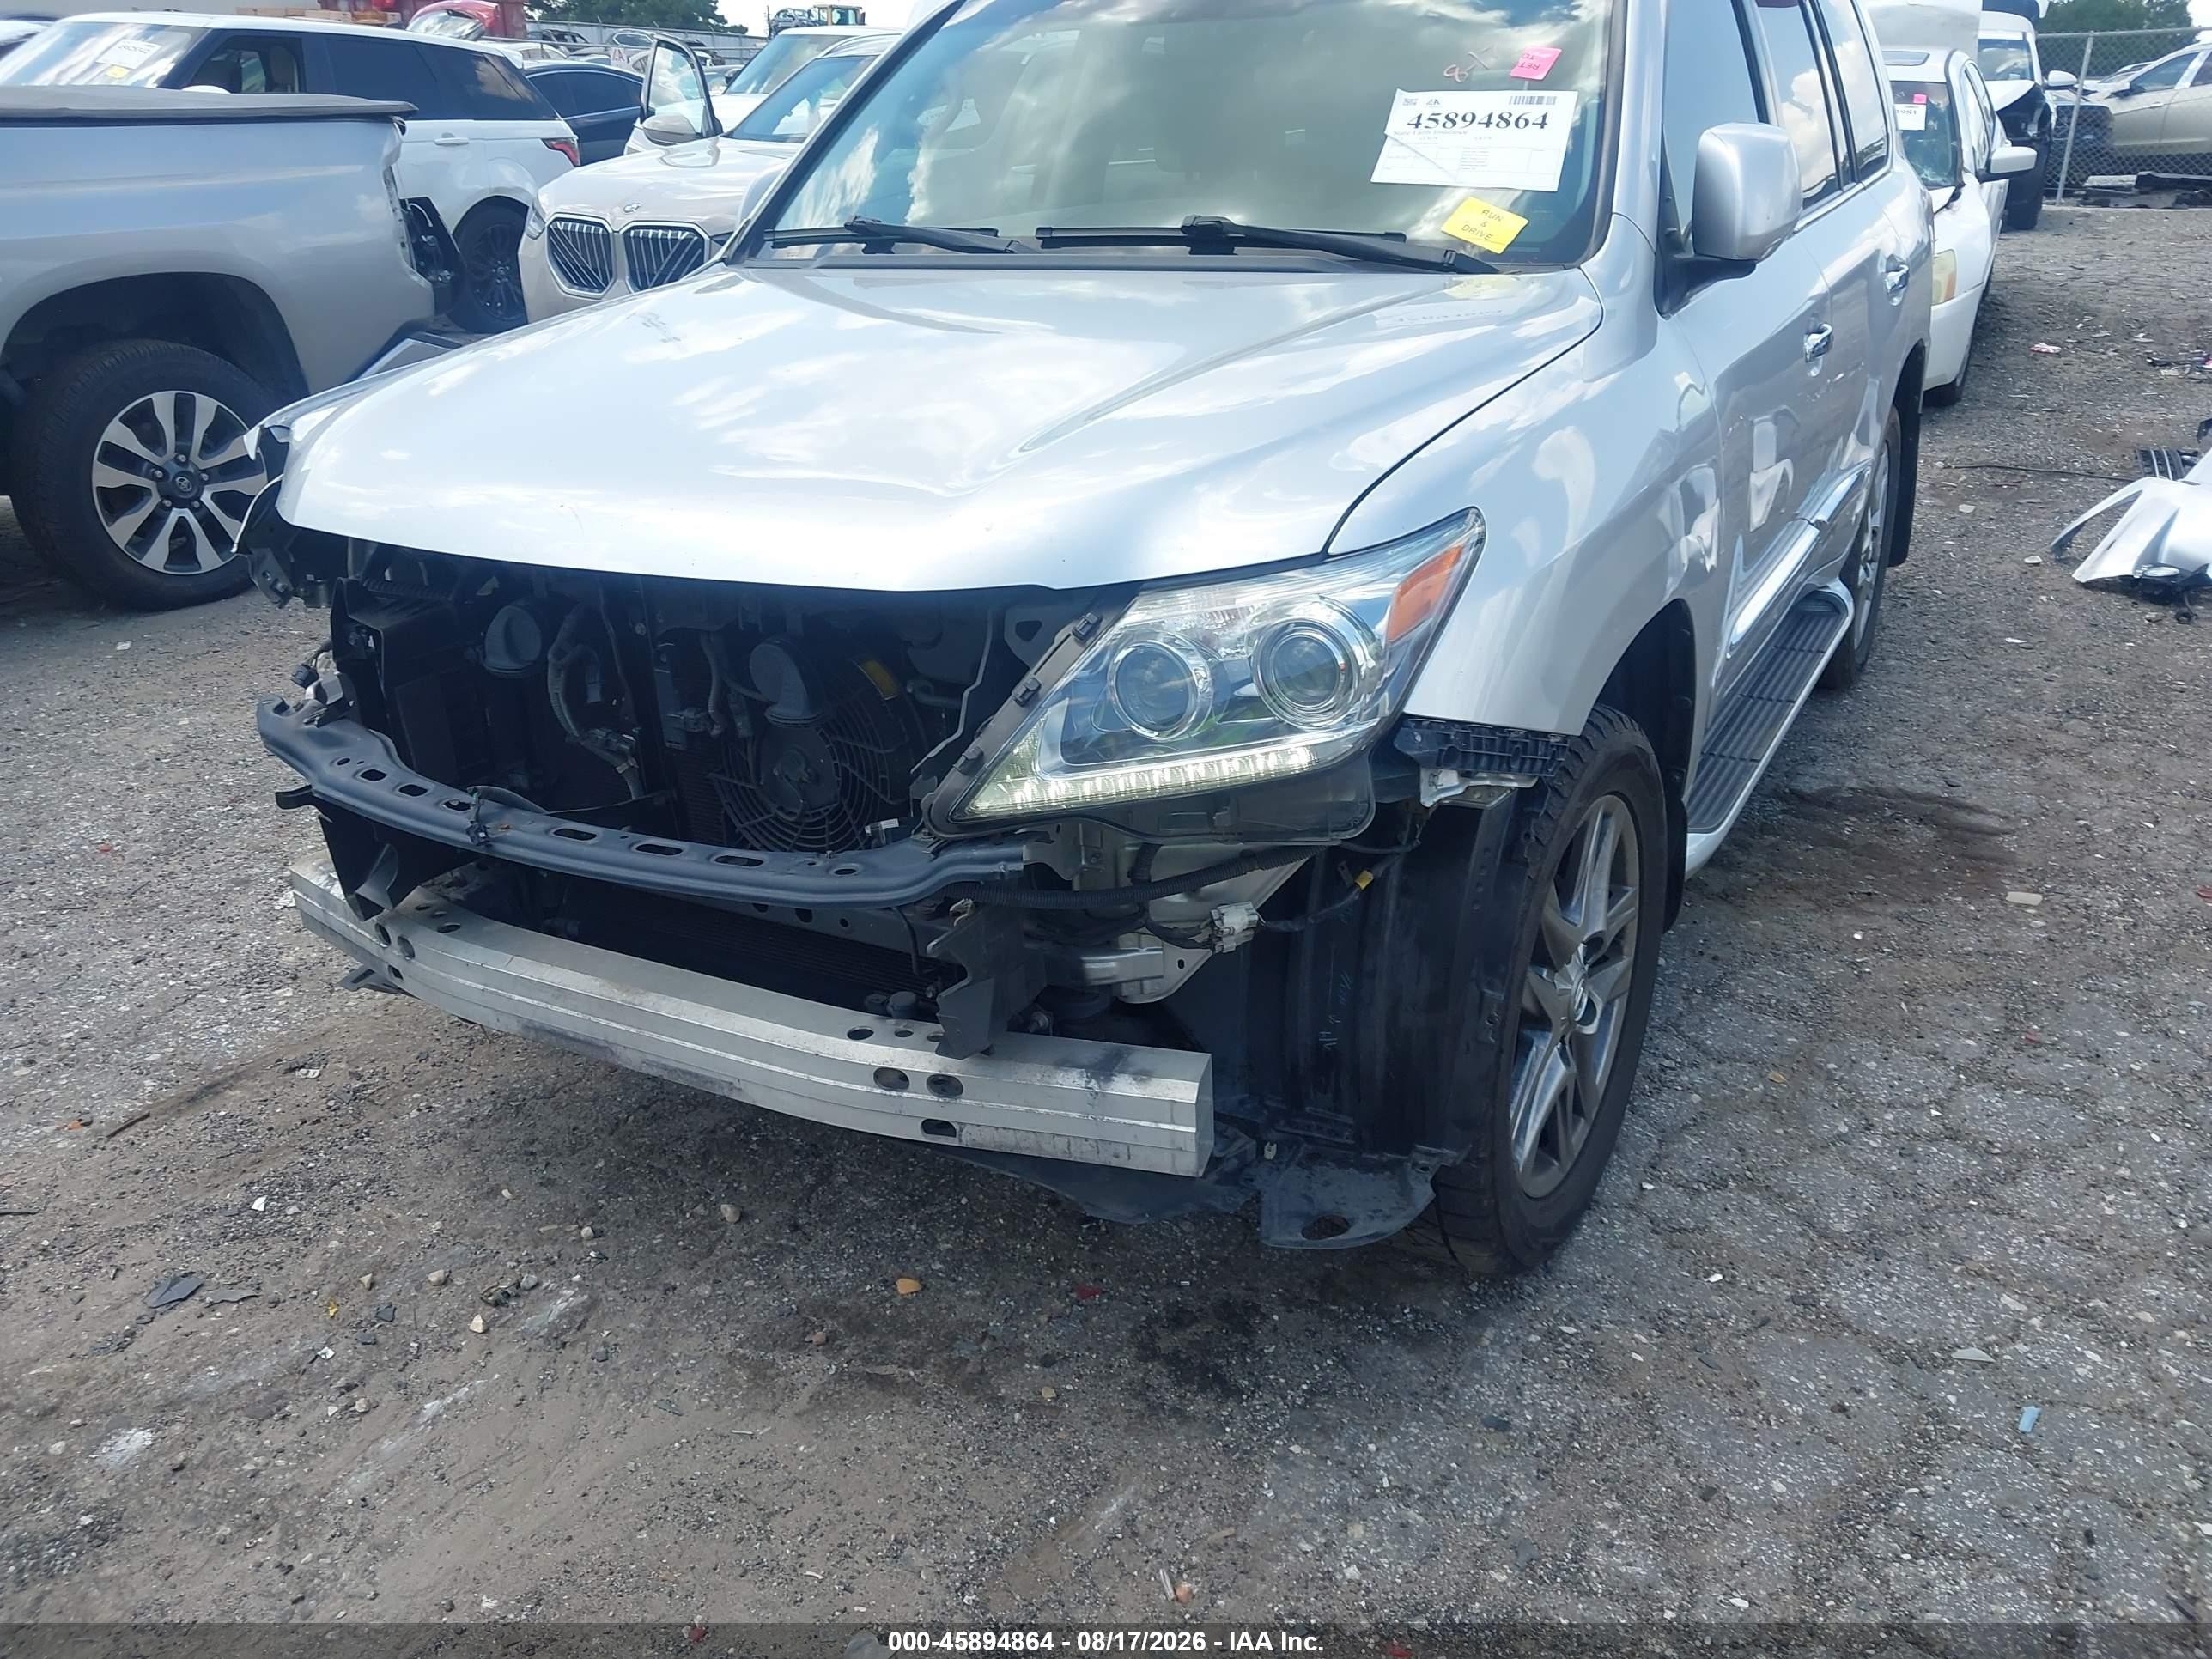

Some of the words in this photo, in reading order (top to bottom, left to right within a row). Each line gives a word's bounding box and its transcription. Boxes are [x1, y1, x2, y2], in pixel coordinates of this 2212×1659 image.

[1407, 111, 1548, 129] 45894864
[1481, 209, 1504, 222] RUN
[1462, 224, 1495, 241] DRIVE
